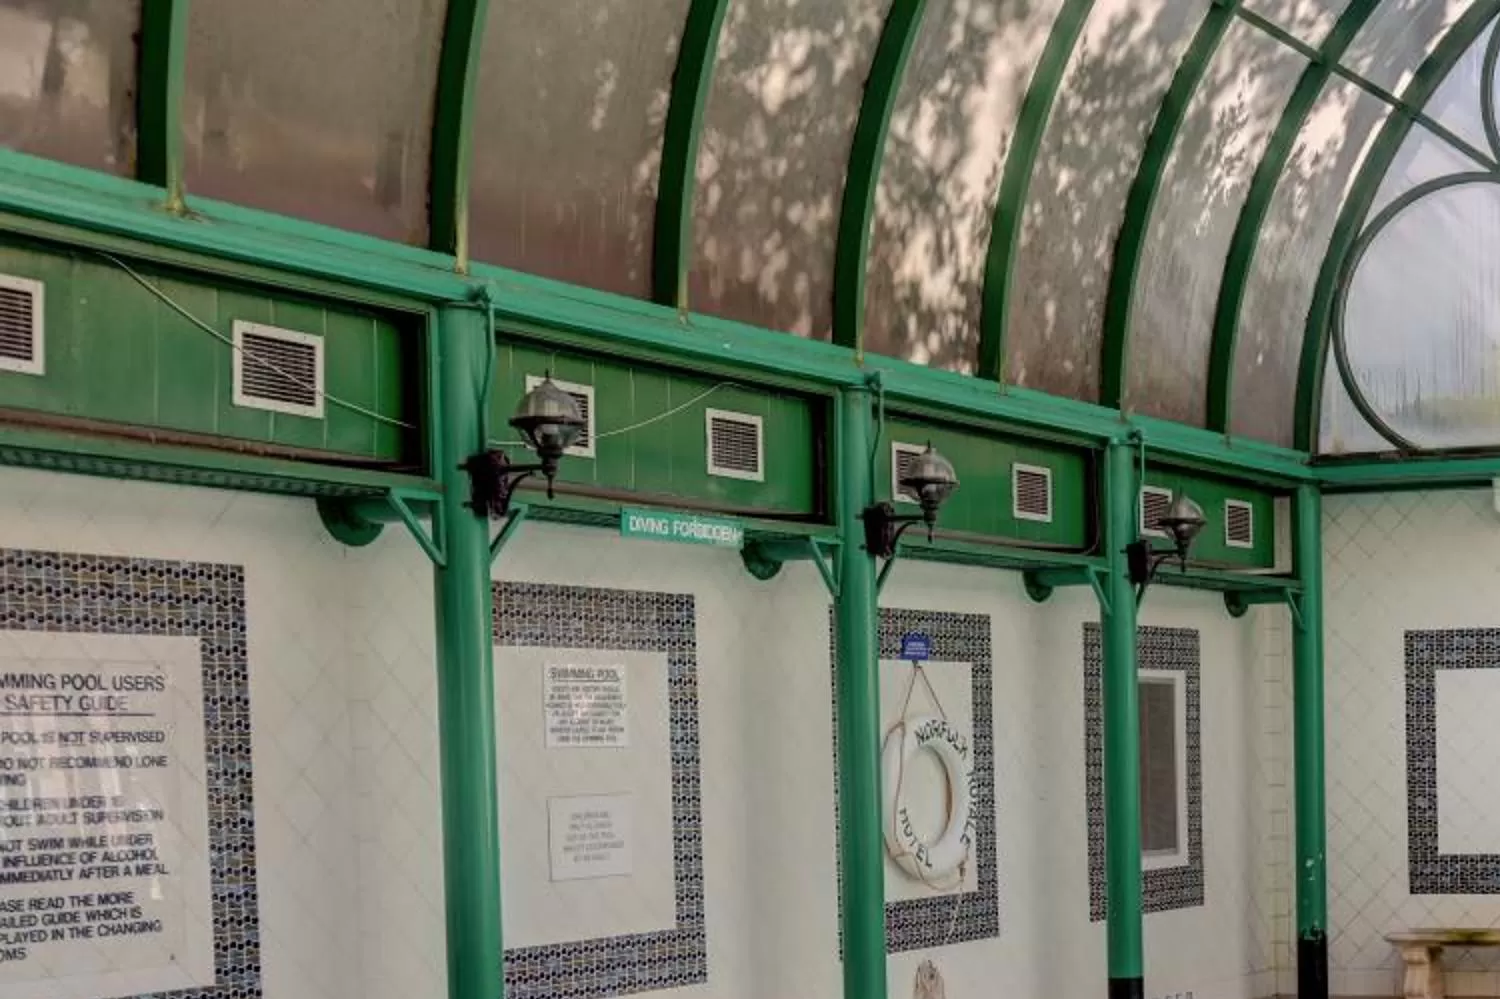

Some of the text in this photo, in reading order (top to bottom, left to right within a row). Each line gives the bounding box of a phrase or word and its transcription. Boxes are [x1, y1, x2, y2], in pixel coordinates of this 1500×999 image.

[629, 515, 744, 544] DIVING FORBIDDEN
[61, 674, 108, 691] POOL
[112, 675, 165, 691] USERS
[5, 694, 129, 711] SAFETY GUIDE
[1, 731, 37, 745] POOL
[58, 731, 86, 744] NOT
[89, 731, 165, 744] SUPERVISED
[18, 757, 45, 770] NOT
[28, 837, 64, 851] SWIM
[68, 835, 107, 849] WHILE
[2, 848, 159, 868] INFLUENCE OF ALCOHOL
[79, 865, 120, 881] AFTER
[123, 864, 133, 877] A
[135, 863, 169, 877] MEAL
[29, 897, 65, 911] READ
[68, 894, 94, 907] THE
[97, 891, 135, 905] MORE
[41, 911, 81, 927] GUIDE
[85, 908, 127, 922] WHICH
[130, 905, 142, 919] IS
[51, 928, 65, 941] IN
[68, 925, 94, 939] THE
[97, 919, 163, 937] CHANGING
